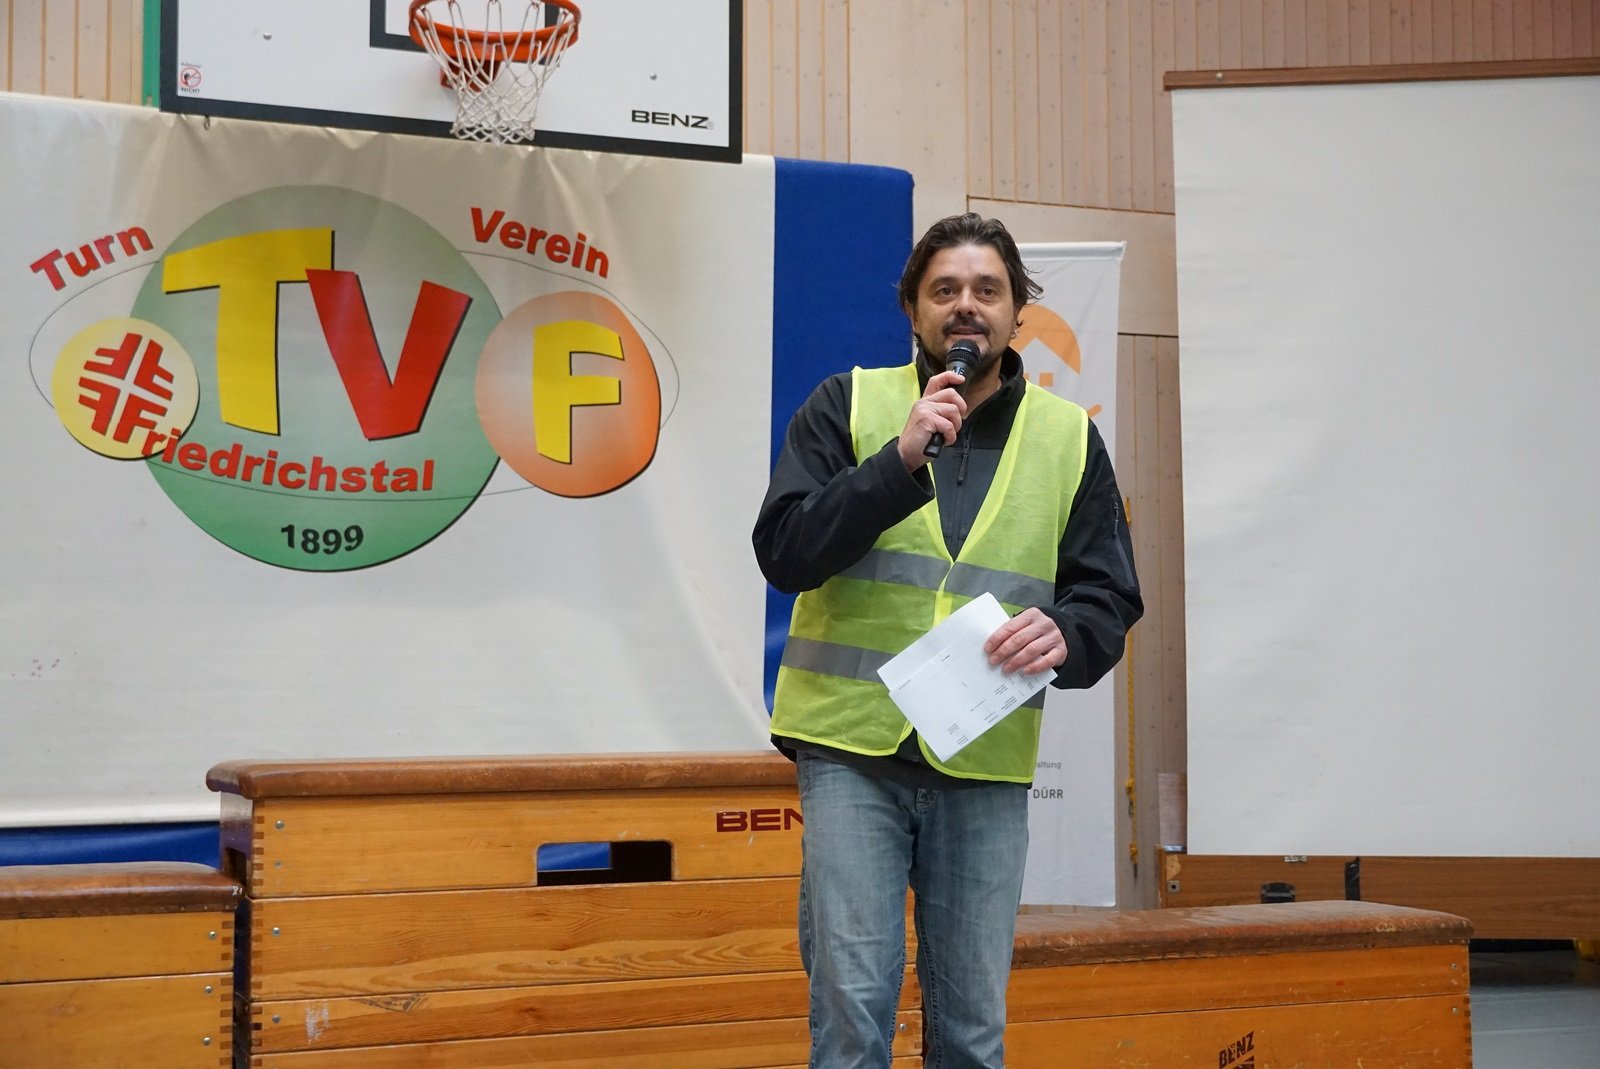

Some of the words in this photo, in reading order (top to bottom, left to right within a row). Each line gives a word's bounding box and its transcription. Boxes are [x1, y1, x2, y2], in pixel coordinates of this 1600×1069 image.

[631, 110, 712, 130] BENZ
[470, 206, 609, 279] Verein
[30, 226, 154, 291] Turn
[280, 524, 364, 555] 1899
[1036, 760, 1062, 770] altung
[1033, 786, 1064, 799] DÜRR
[716, 808, 804, 833] BEN
[1218, 1030, 1255, 1069] BENZ
